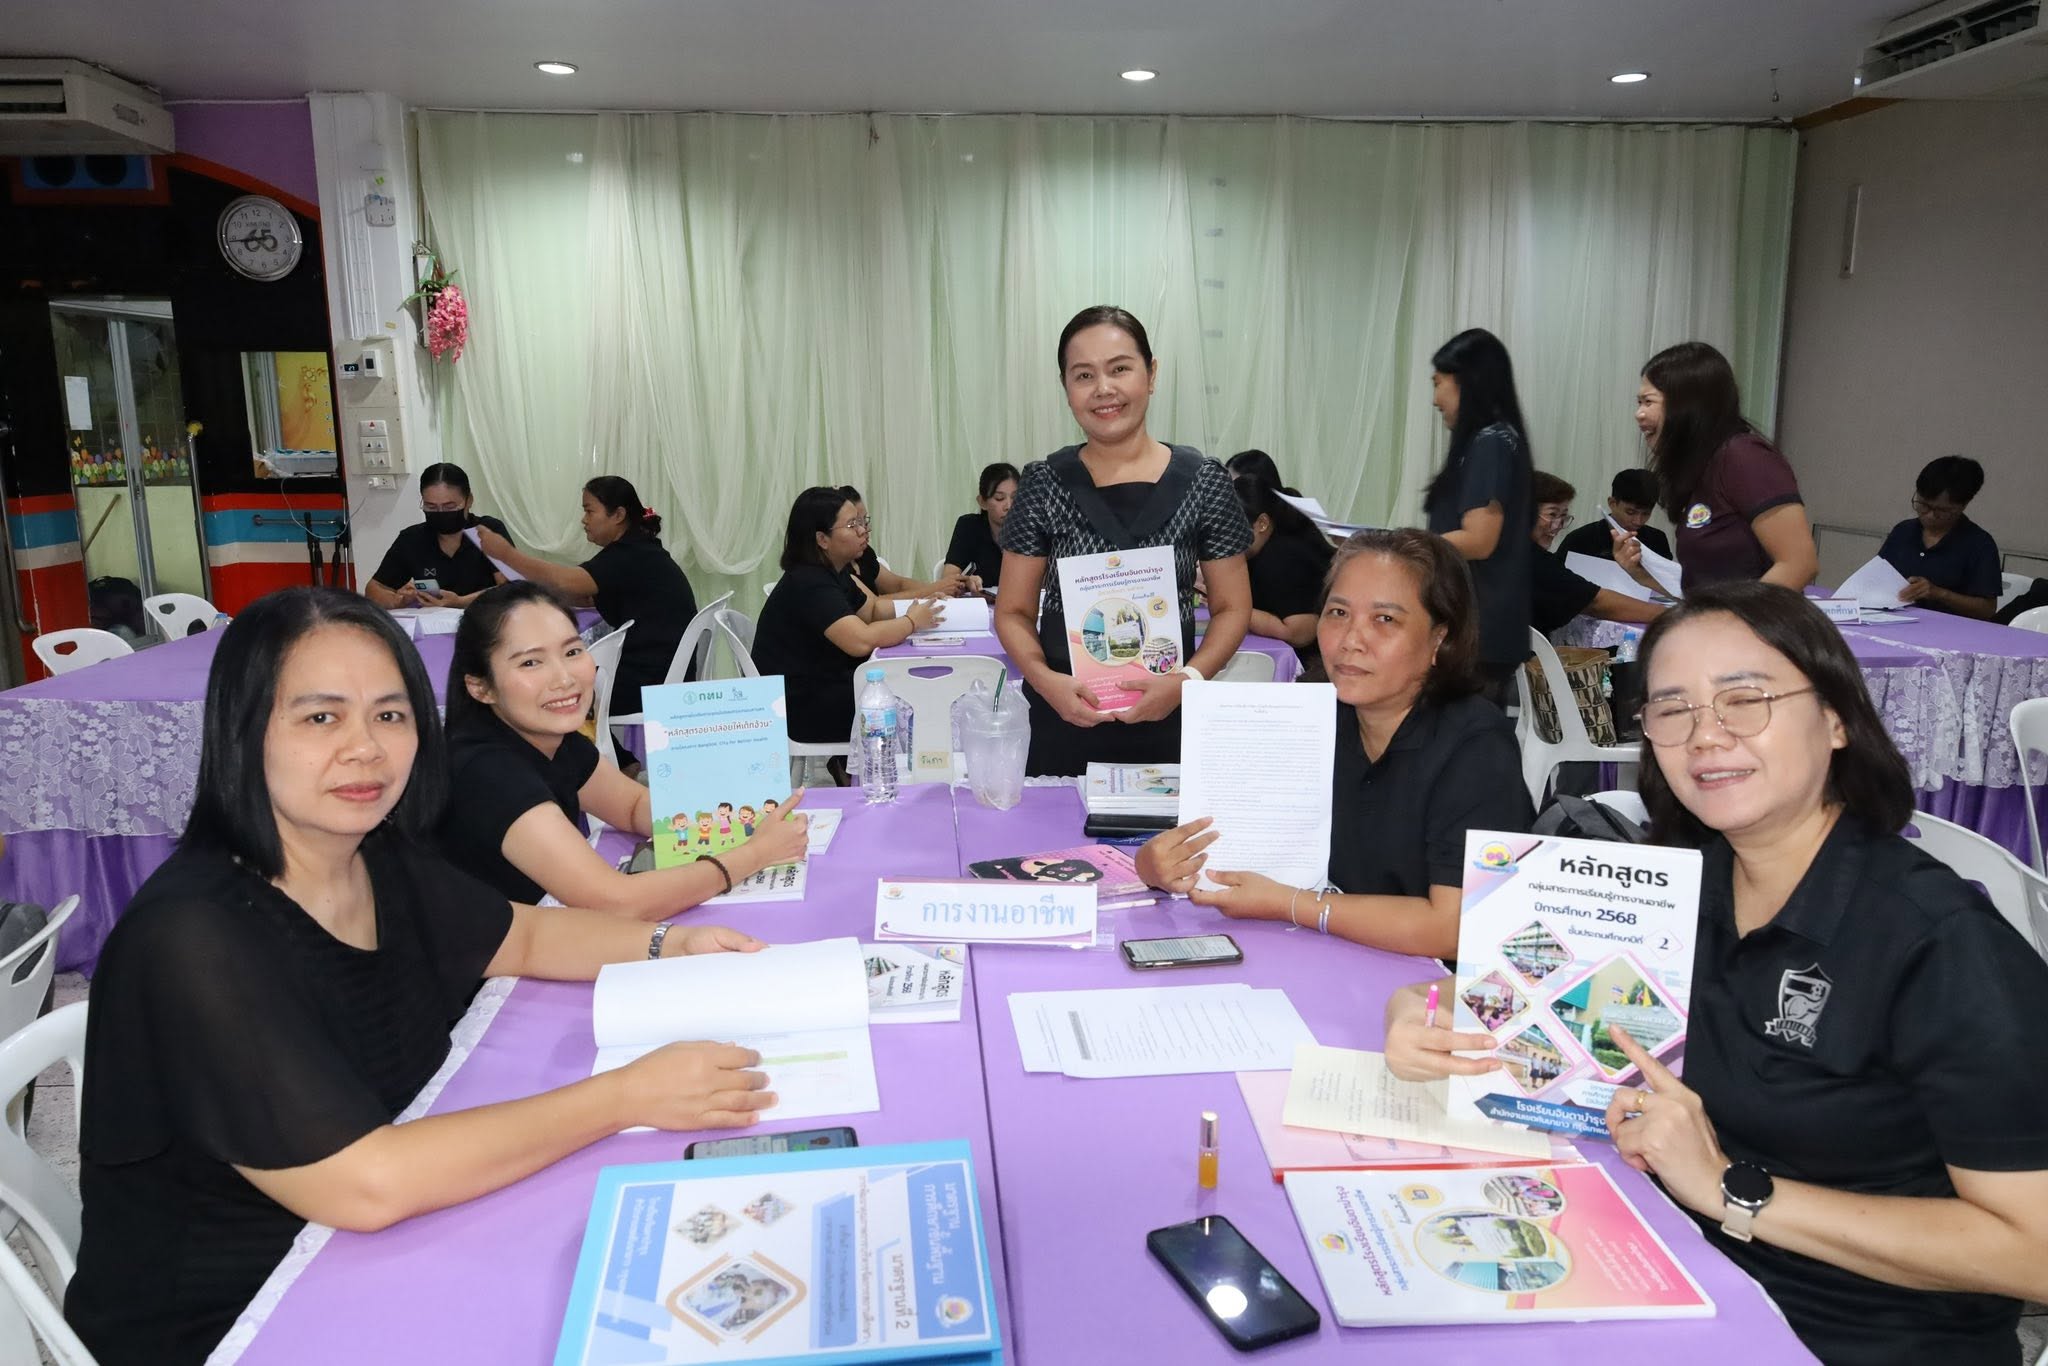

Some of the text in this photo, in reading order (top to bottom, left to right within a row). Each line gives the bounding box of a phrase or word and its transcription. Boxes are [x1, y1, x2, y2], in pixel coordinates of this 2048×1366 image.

[1559, 855, 1669, 888] หลักสูตร
[922, 893, 1075, 926] การงานอาชีพ
[1534, 901, 1637, 925] ปีการศึกษา 2568
[1658, 937, 1670, 950] 2
[895, 1319, 910, 1329] 2
